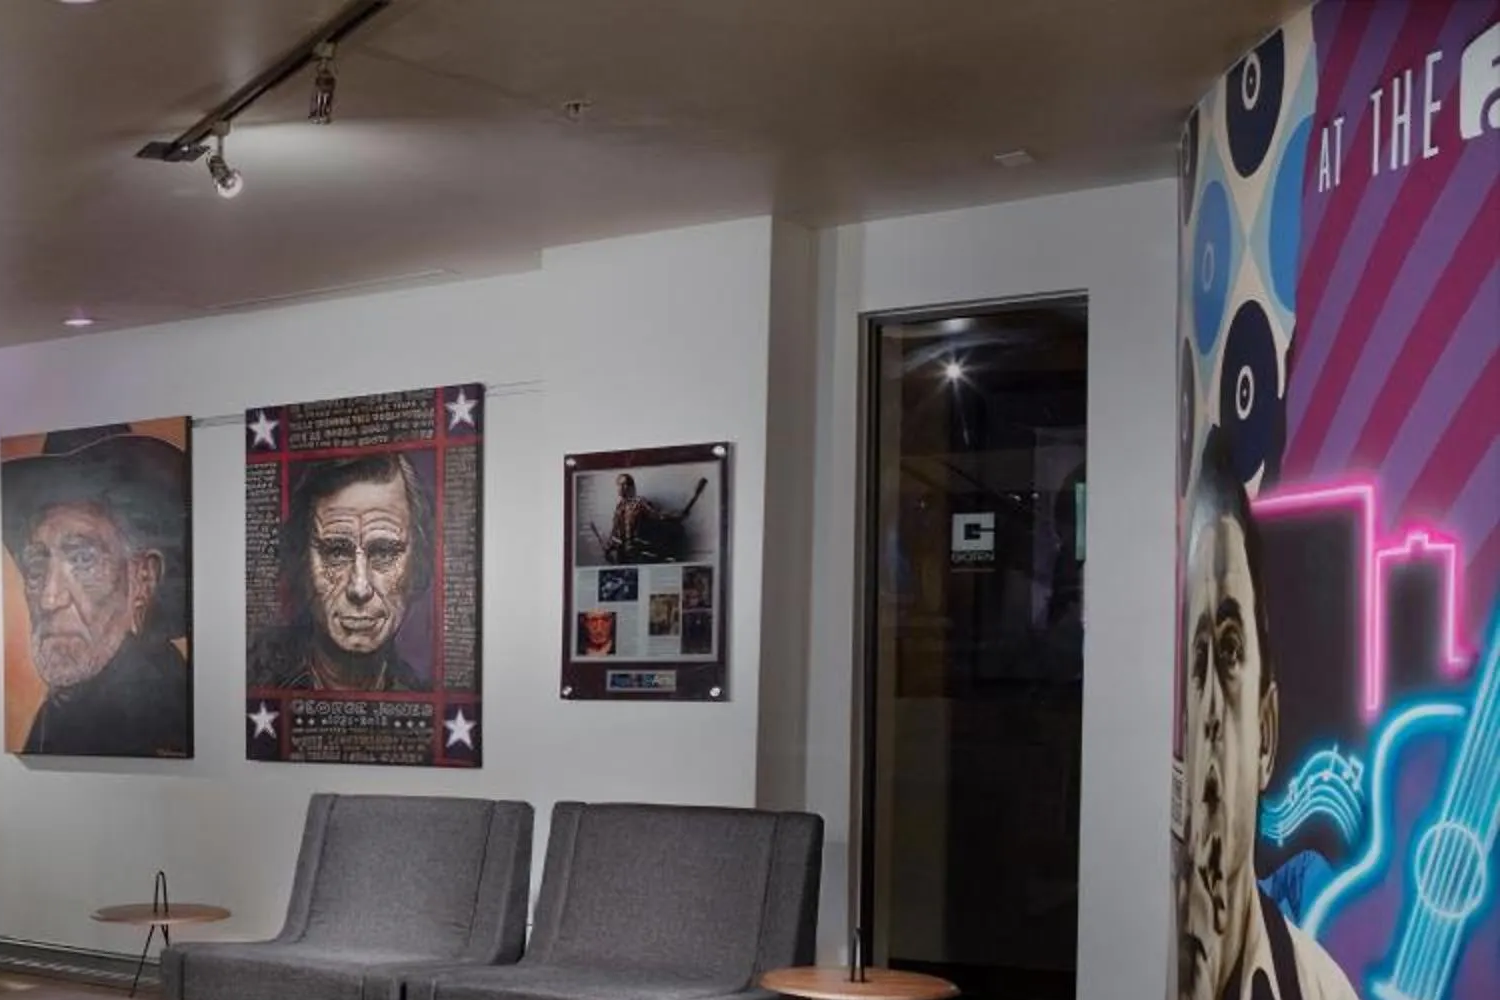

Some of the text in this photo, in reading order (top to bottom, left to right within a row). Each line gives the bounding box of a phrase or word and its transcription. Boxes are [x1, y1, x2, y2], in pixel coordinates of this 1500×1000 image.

[1318, 117, 1345, 193] AT
[1369, 50, 1443, 176] THE
[291, 699, 367, 715] GEORGE
